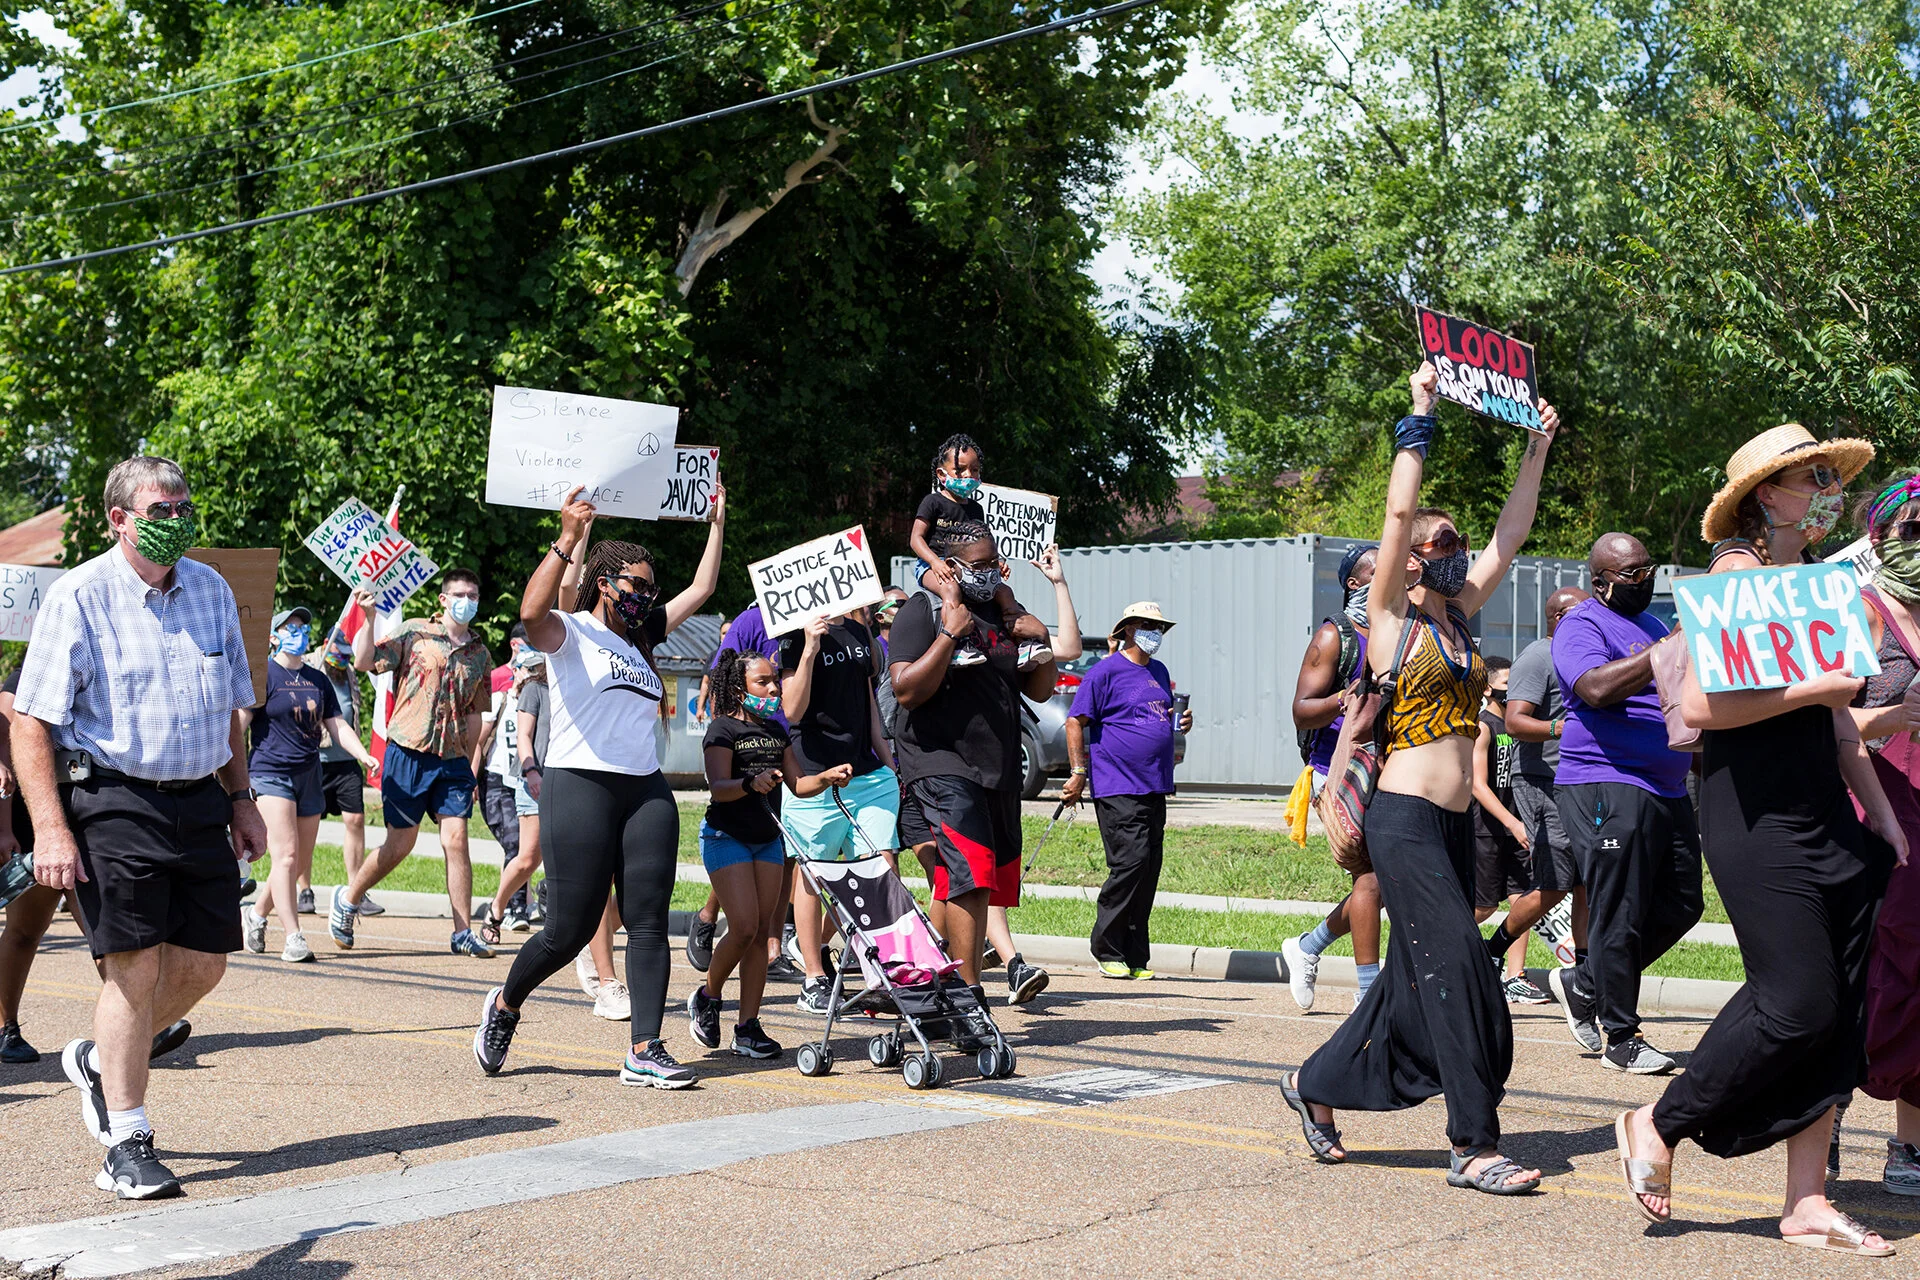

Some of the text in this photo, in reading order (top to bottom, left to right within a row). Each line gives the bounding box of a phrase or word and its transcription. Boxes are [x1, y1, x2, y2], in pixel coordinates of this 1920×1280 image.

[1422, 312, 1527, 378] BLOOD
[1434, 355, 1534, 408] IS ON YOUR
[510, 392, 613, 420] Silence
[1481, 391, 1546, 433] AMERICA
[515, 448, 583, 469] Violence
[676, 451, 711, 478] FOR
[527, 480, 625, 504] #PACE
[987, 492, 1057, 525] PRETENDING
[309, 501, 364, 547] THE ONLY
[322, 510, 376, 560] REASON
[986, 514, 1046, 542] RACISM
[336, 520, 389, 574] I'M NOT
[347, 536, 405, 588] IN JAIL
[757, 538, 853, 587] JUSTICE 4
[995, 535, 1050, 562] IOTISM
[28, 587, 40, 610] A
[375, 566, 400, 589] THAT
[375, 561, 434, 614] WHITE.
[763, 559, 875, 626] RICKY BALL
[1678, 569, 1857, 629] WAKE UP
[1694, 613, 1883, 688] AMERICA
[610, 660, 661, 690] Beautifu
[760, 737, 776, 749] Girl
